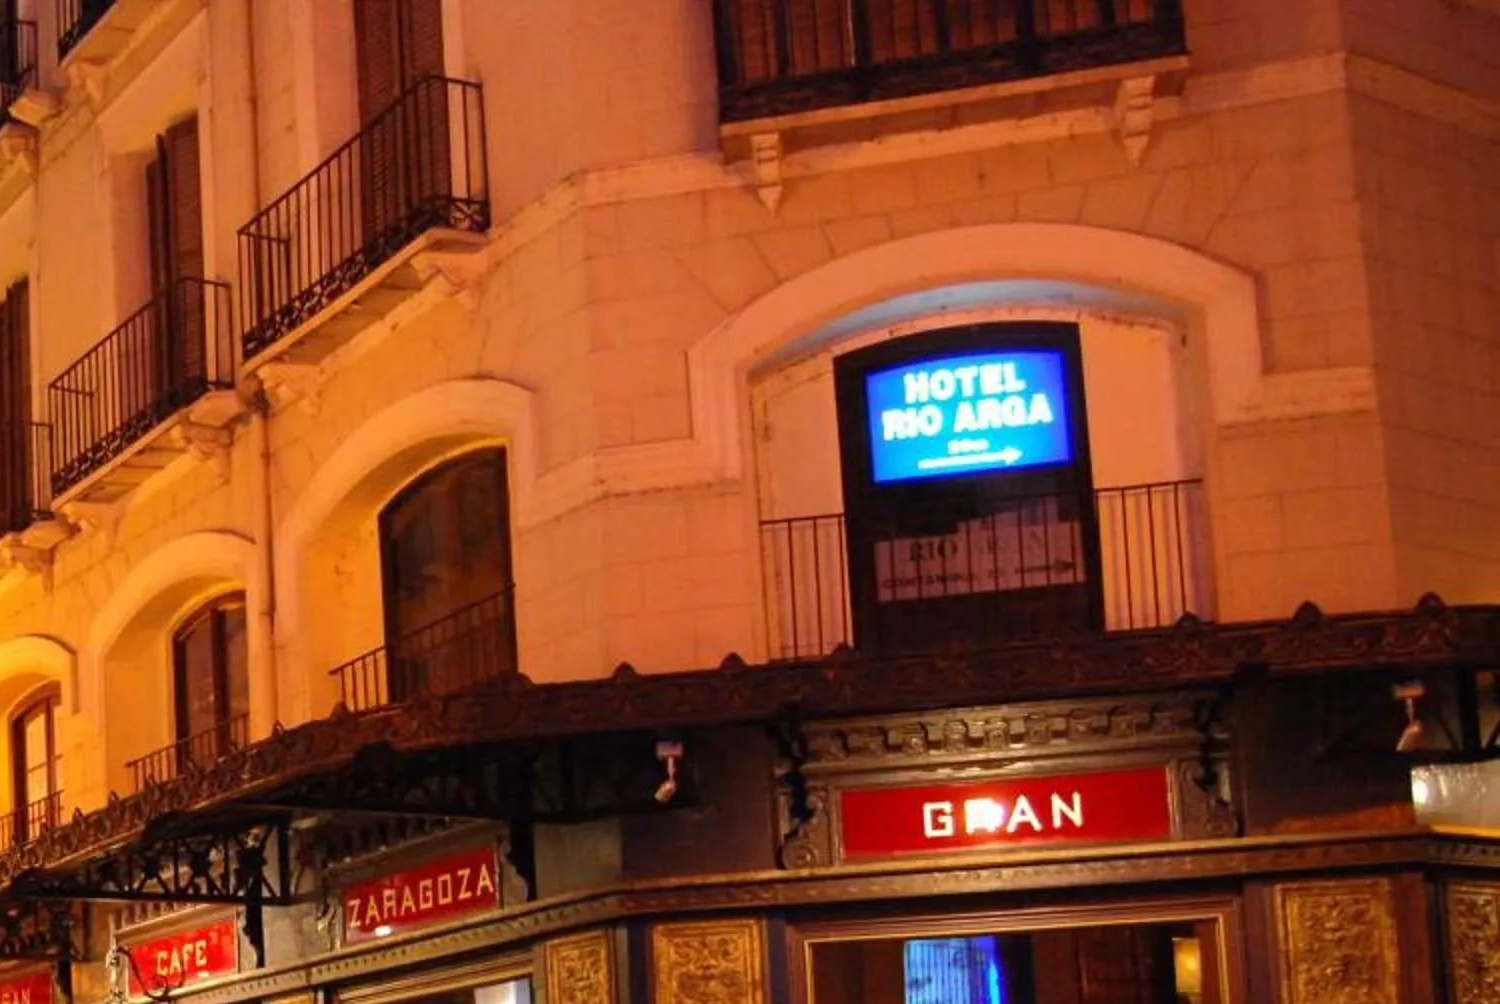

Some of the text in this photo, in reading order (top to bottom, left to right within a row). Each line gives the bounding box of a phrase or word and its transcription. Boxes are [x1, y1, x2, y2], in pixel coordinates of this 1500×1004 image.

[903, 361, 1026, 404] HOTEL
[881, 393, 1054, 441] RIO ARGA
[923, 791, 1083, 838] GRAN
[348, 864, 494, 928] ZARAGOZA
[156, 939, 207, 976] CAFE
